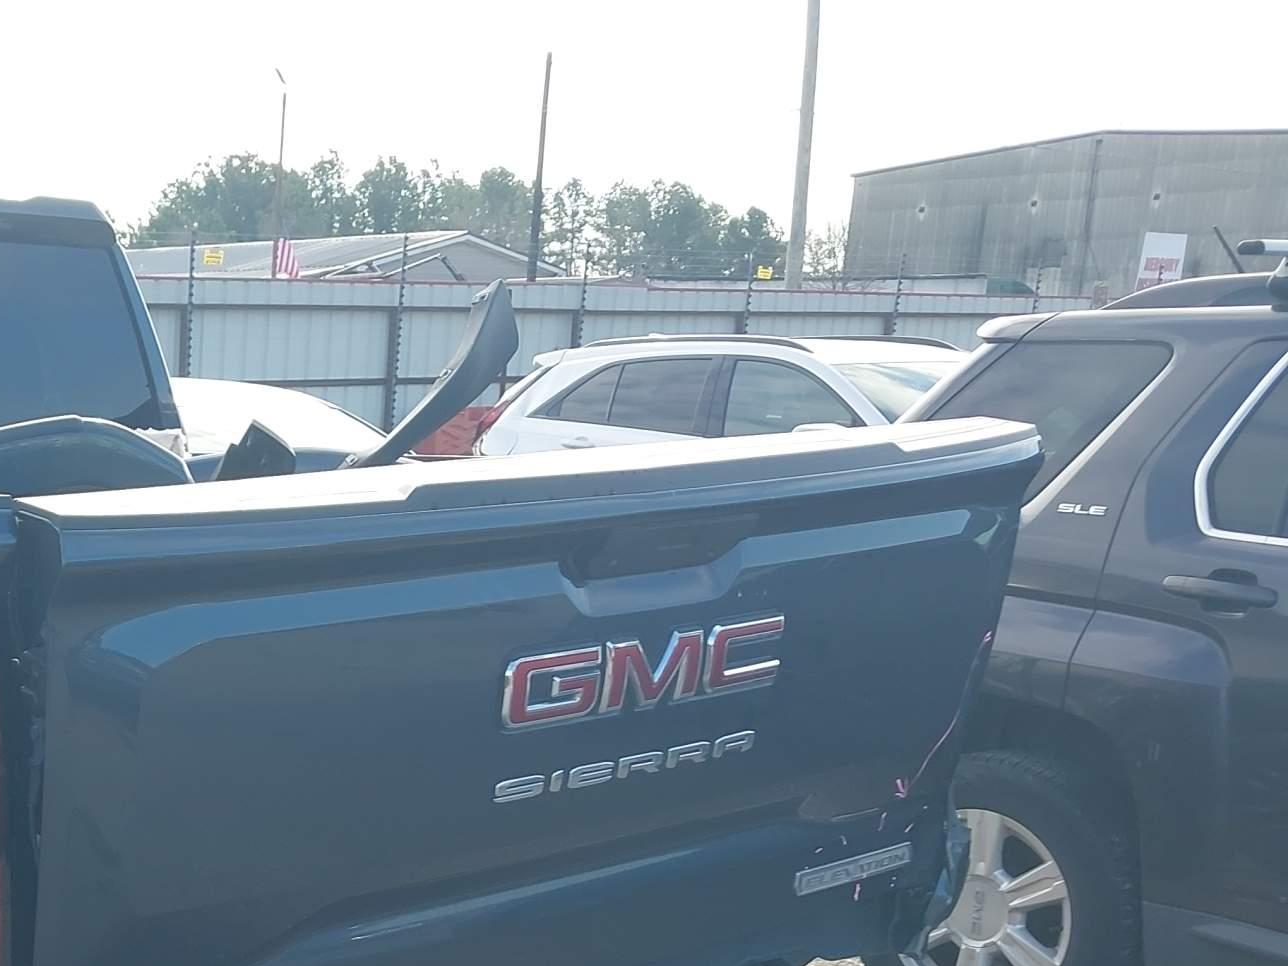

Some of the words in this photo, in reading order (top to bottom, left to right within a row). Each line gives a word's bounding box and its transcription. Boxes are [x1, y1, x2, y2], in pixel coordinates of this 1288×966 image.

[1056, 502, 1108, 516] SLE
[501, 612, 785, 732] GMC
[492, 730, 756, 803] SIERRA
